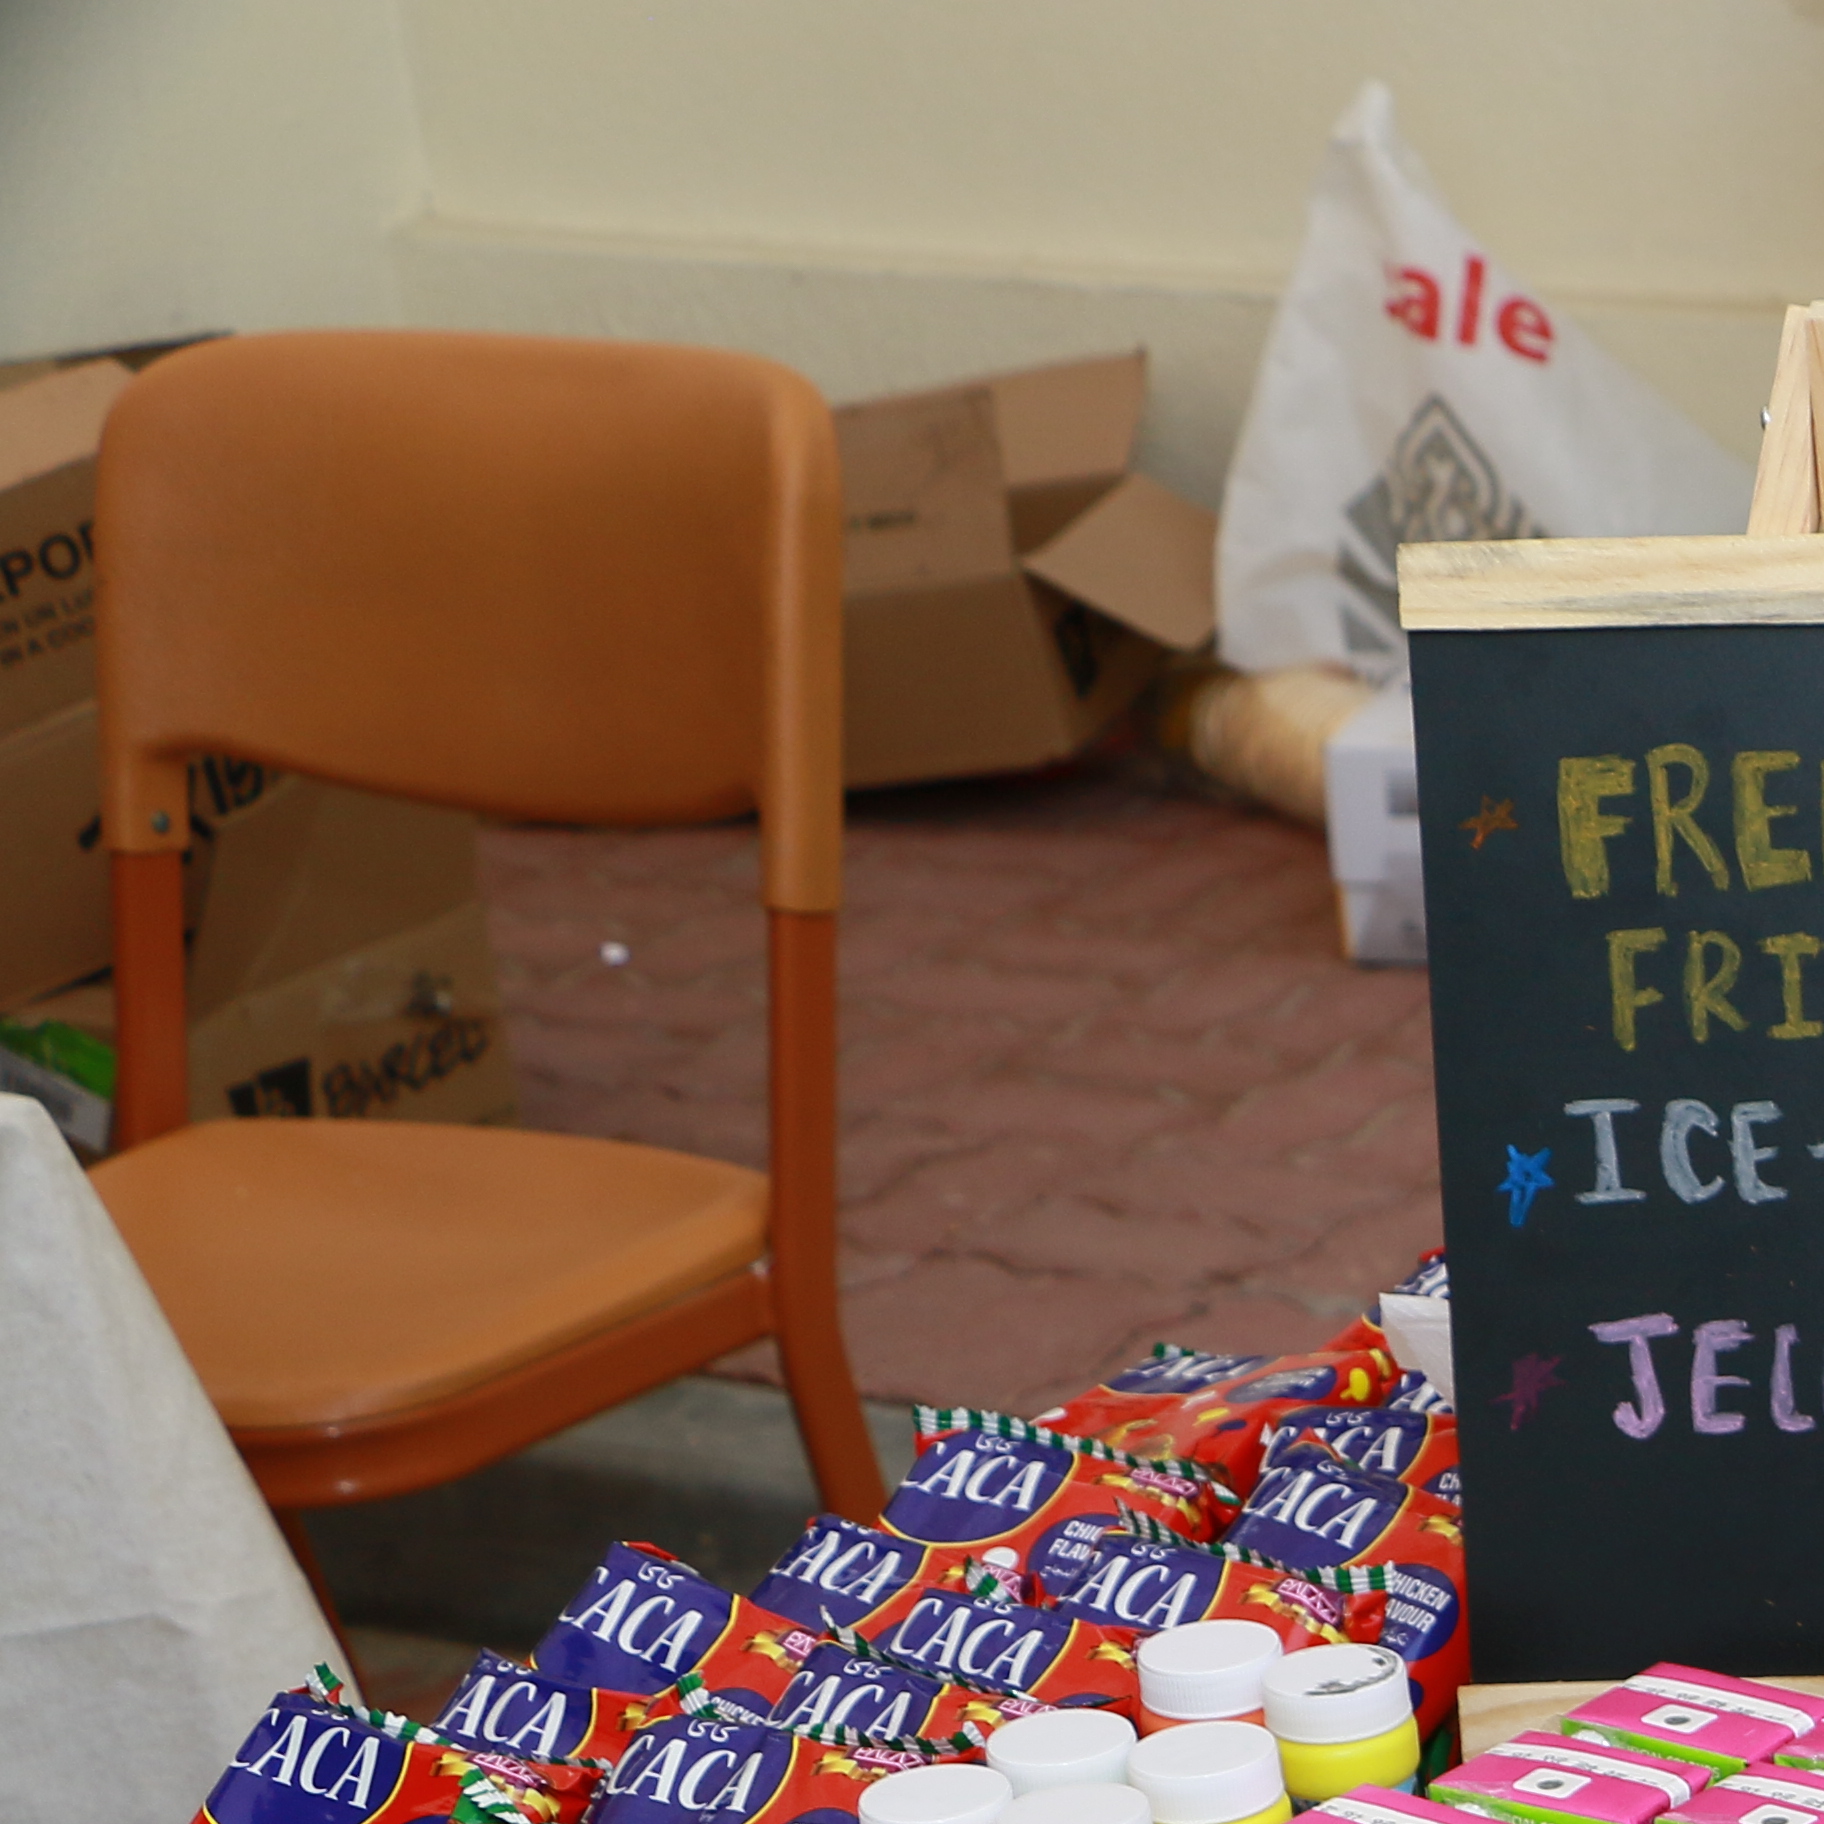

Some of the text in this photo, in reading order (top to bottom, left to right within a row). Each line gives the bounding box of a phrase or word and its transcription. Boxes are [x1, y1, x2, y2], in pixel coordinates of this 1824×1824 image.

[1386, 1598, 1438, 1632] AVOUR
[1392, 1569, 1452, 1609] HICKEN
[891, 1597, 1044, 1687] CACA
[436, 1673, 567, 1757] ACA
[766, 1670, 912, 1741] CACA
[605, 1734, 764, 1814] CACA
